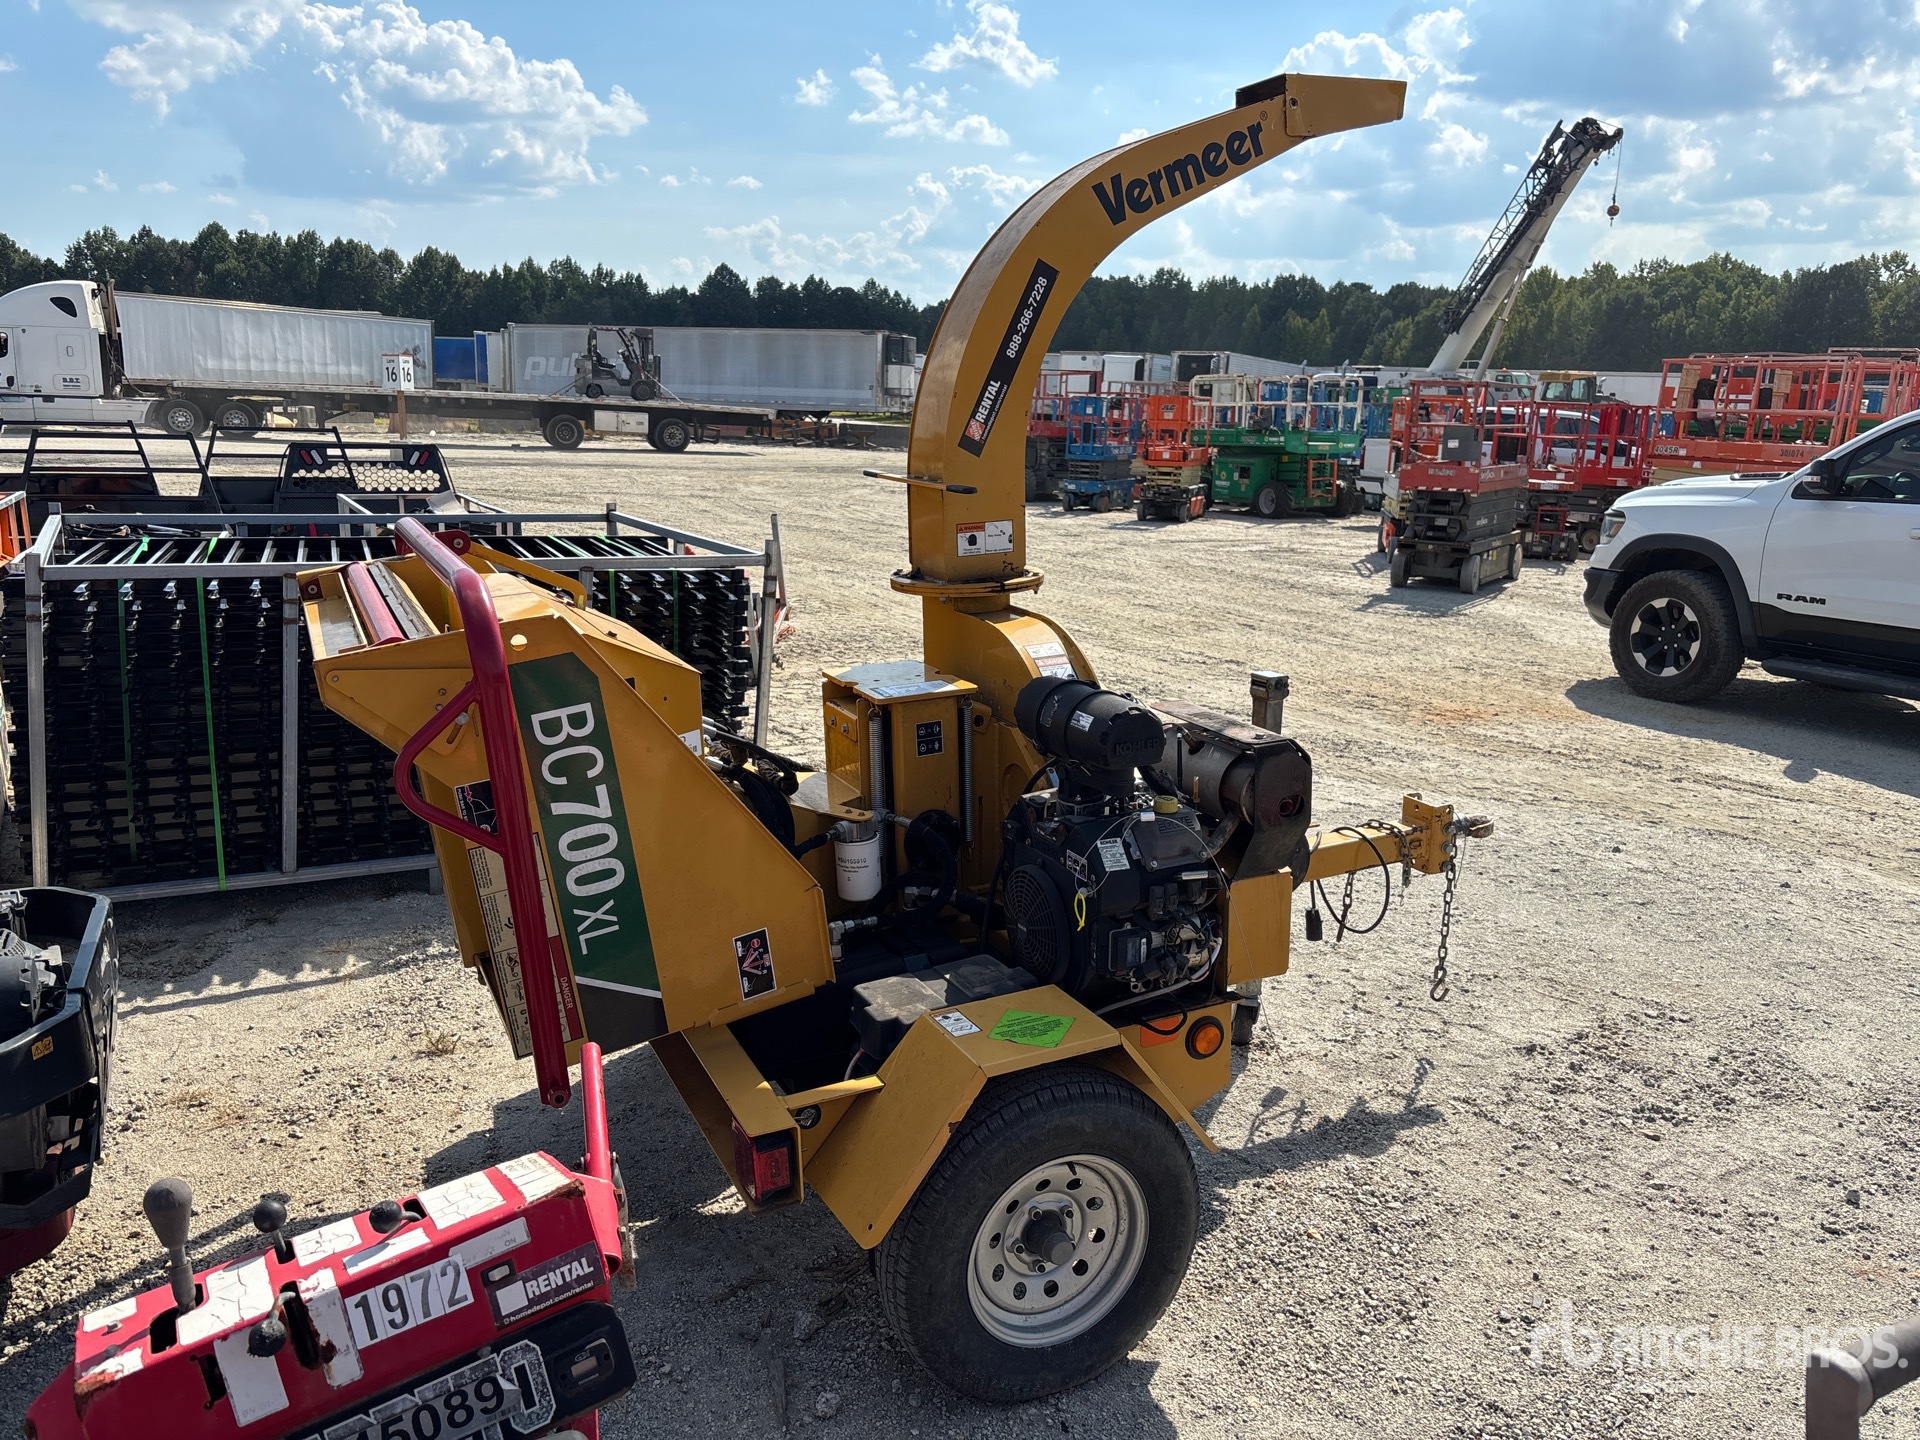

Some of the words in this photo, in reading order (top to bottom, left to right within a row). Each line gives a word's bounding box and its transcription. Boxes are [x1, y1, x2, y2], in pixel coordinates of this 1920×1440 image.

[1092, 121, 1264, 226] Vermeer
[1005, 276, 1048, 359] 888-266-7228
[385, 366, 398, 383] 16
[401, 366, 412, 383] 16
[974, 379, 1001, 423] RENTAL
[1161, 404, 1177, 412] JLG
[1654, 444, 1679, 455] 4045R
[1776, 592, 1827, 606] RAM
[1114, 738, 1162, 756] KOHLER
[560, 976, 574, 1010] DANGER
[504, 1236, 517, 1247] ON
[524, 1256, 595, 1300] RENTAL
[353, 1259, 469, 1342] 1972
[510, 1280, 594, 1323] homedepot.com/rental
